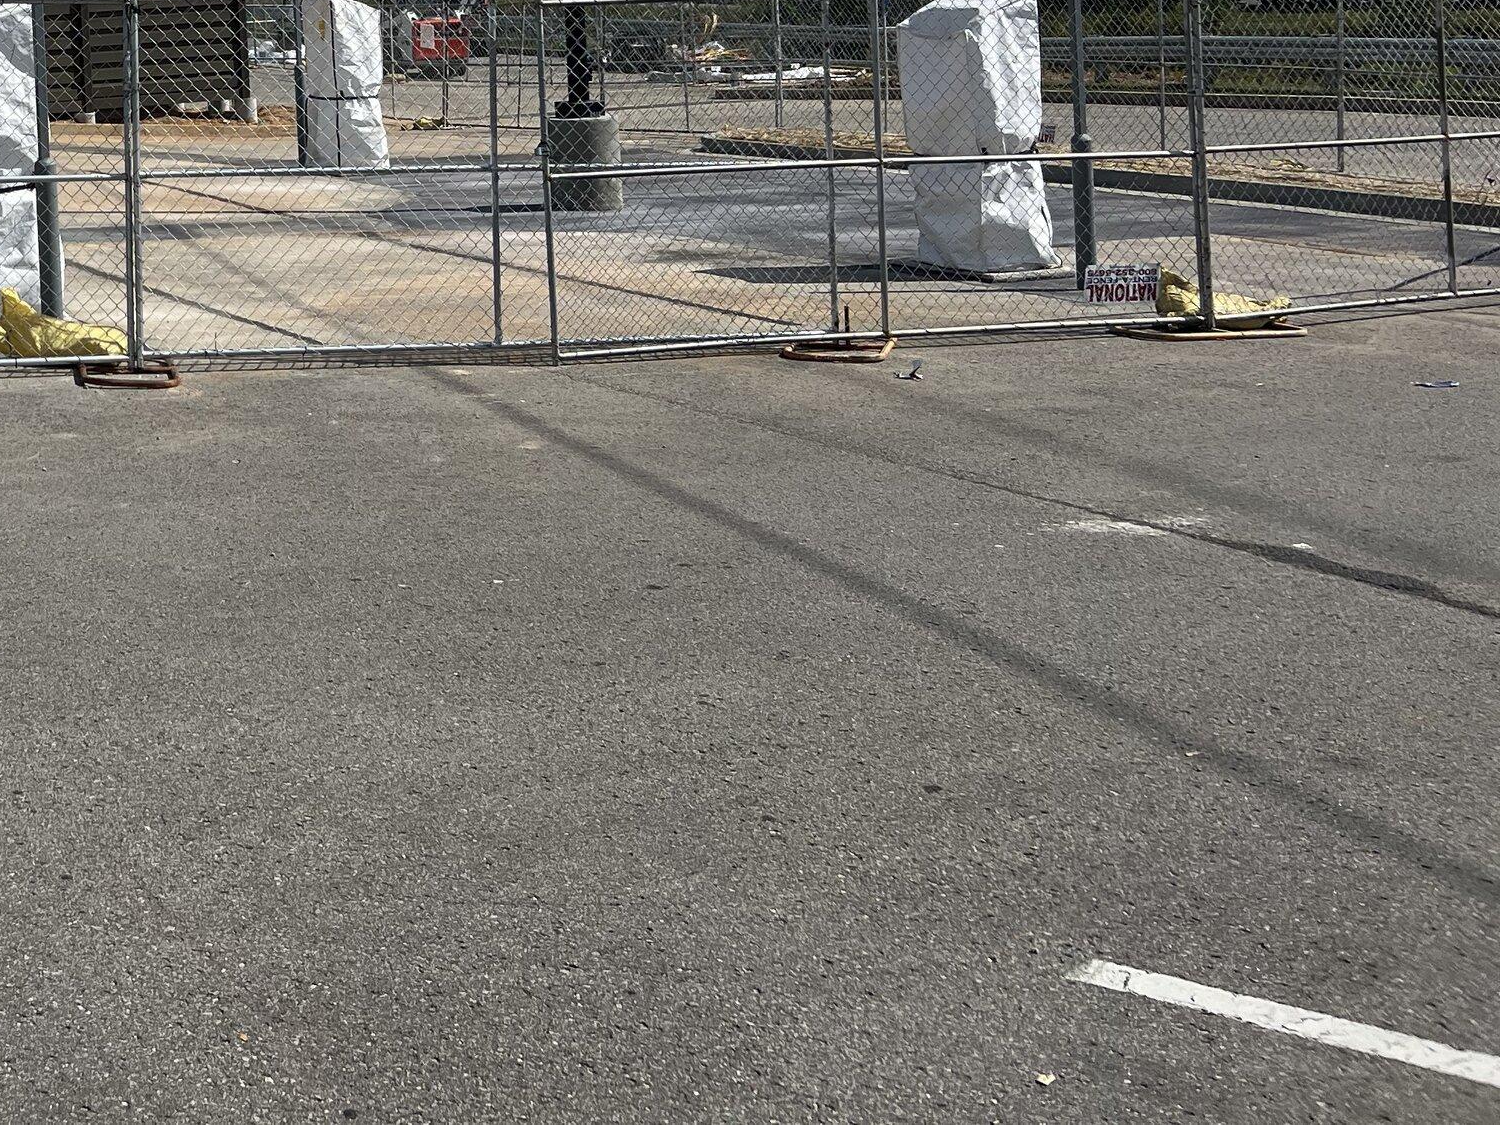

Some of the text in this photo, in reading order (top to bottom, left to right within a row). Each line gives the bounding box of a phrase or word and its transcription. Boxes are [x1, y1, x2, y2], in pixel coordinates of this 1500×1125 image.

[1087, 268, 1157, 276] 800-352-5675
[1086, 275, 1158, 284] RENT-A-FENCE
[1086, 283, 1157, 302] NATIONAL
